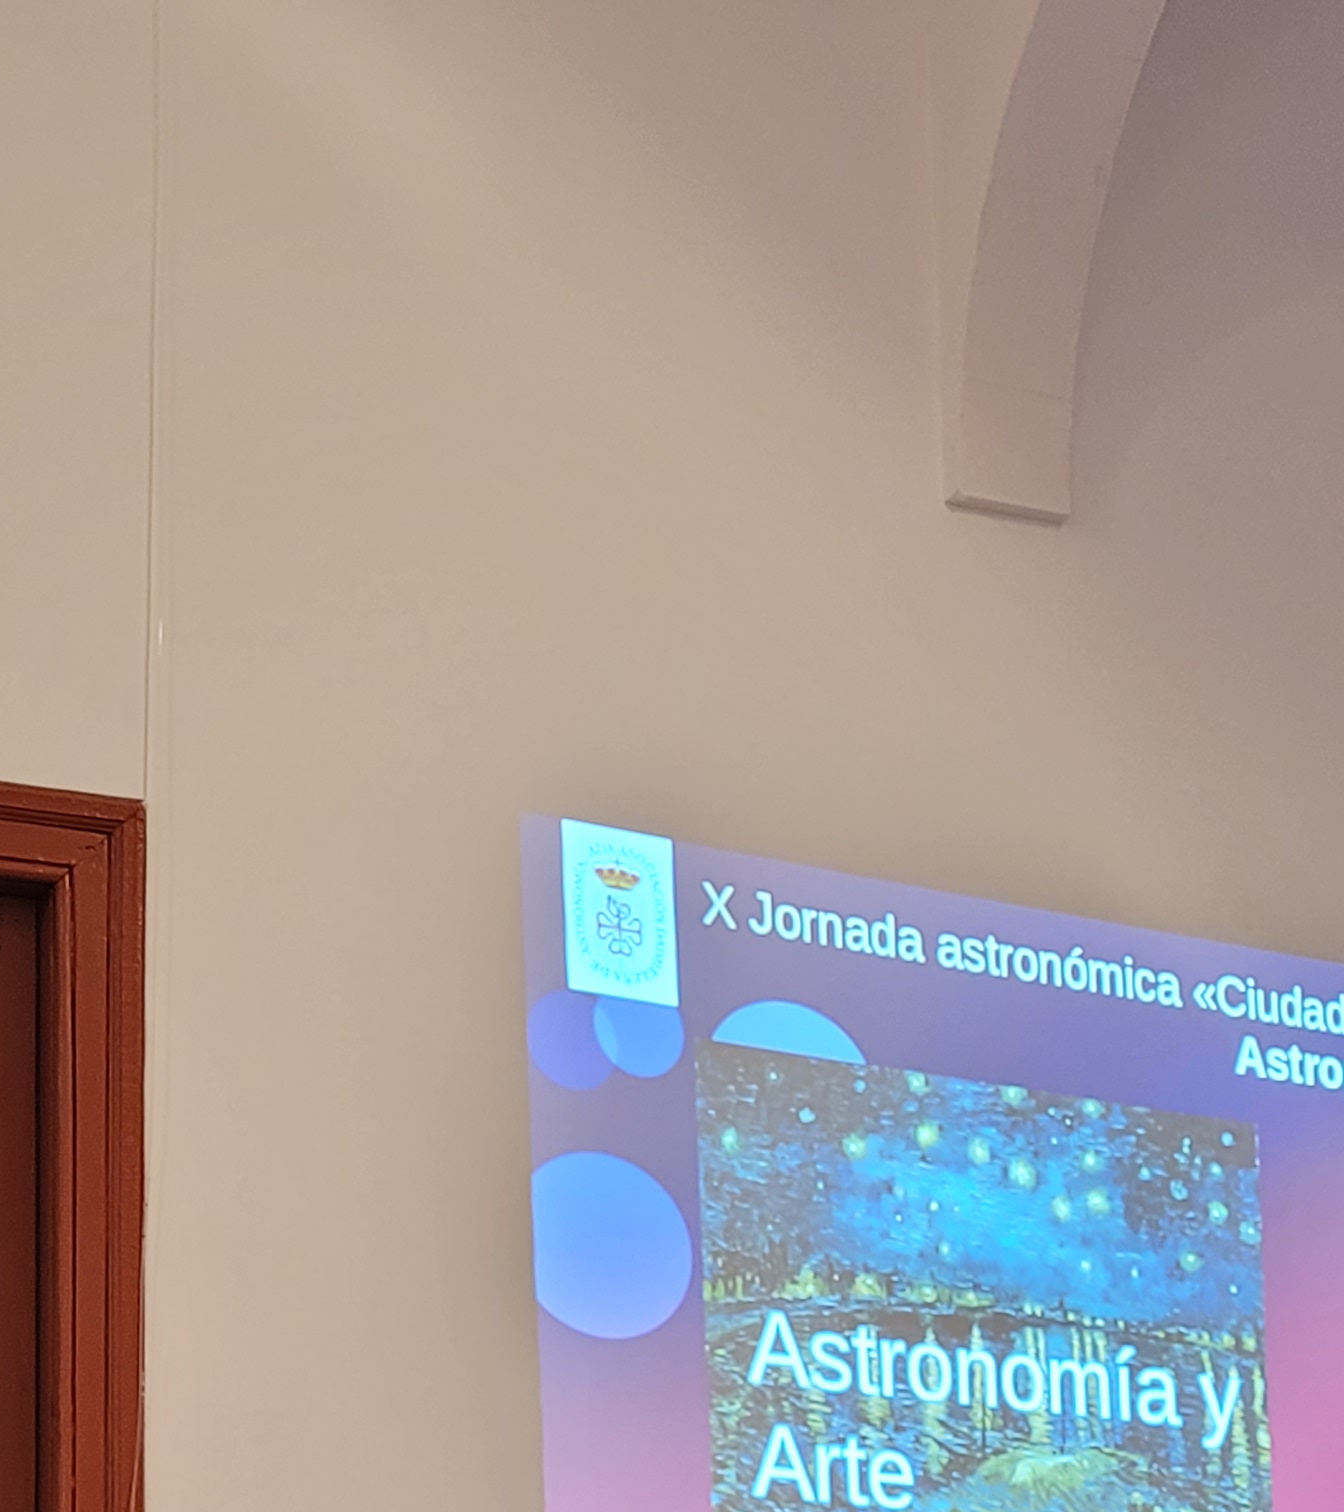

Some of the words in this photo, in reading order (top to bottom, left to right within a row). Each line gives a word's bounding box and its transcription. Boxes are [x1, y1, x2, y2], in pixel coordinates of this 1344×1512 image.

[701, 880, 737, 930] X
[748, 890, 926, 964] Jornada
[936, 932, 1183, 1008] astronómica
[747, 1309, 1183, 1427] Astronomía
[1197, 1371, 1241, 1449] y
[751, 1423, 915, 1509] Arte
